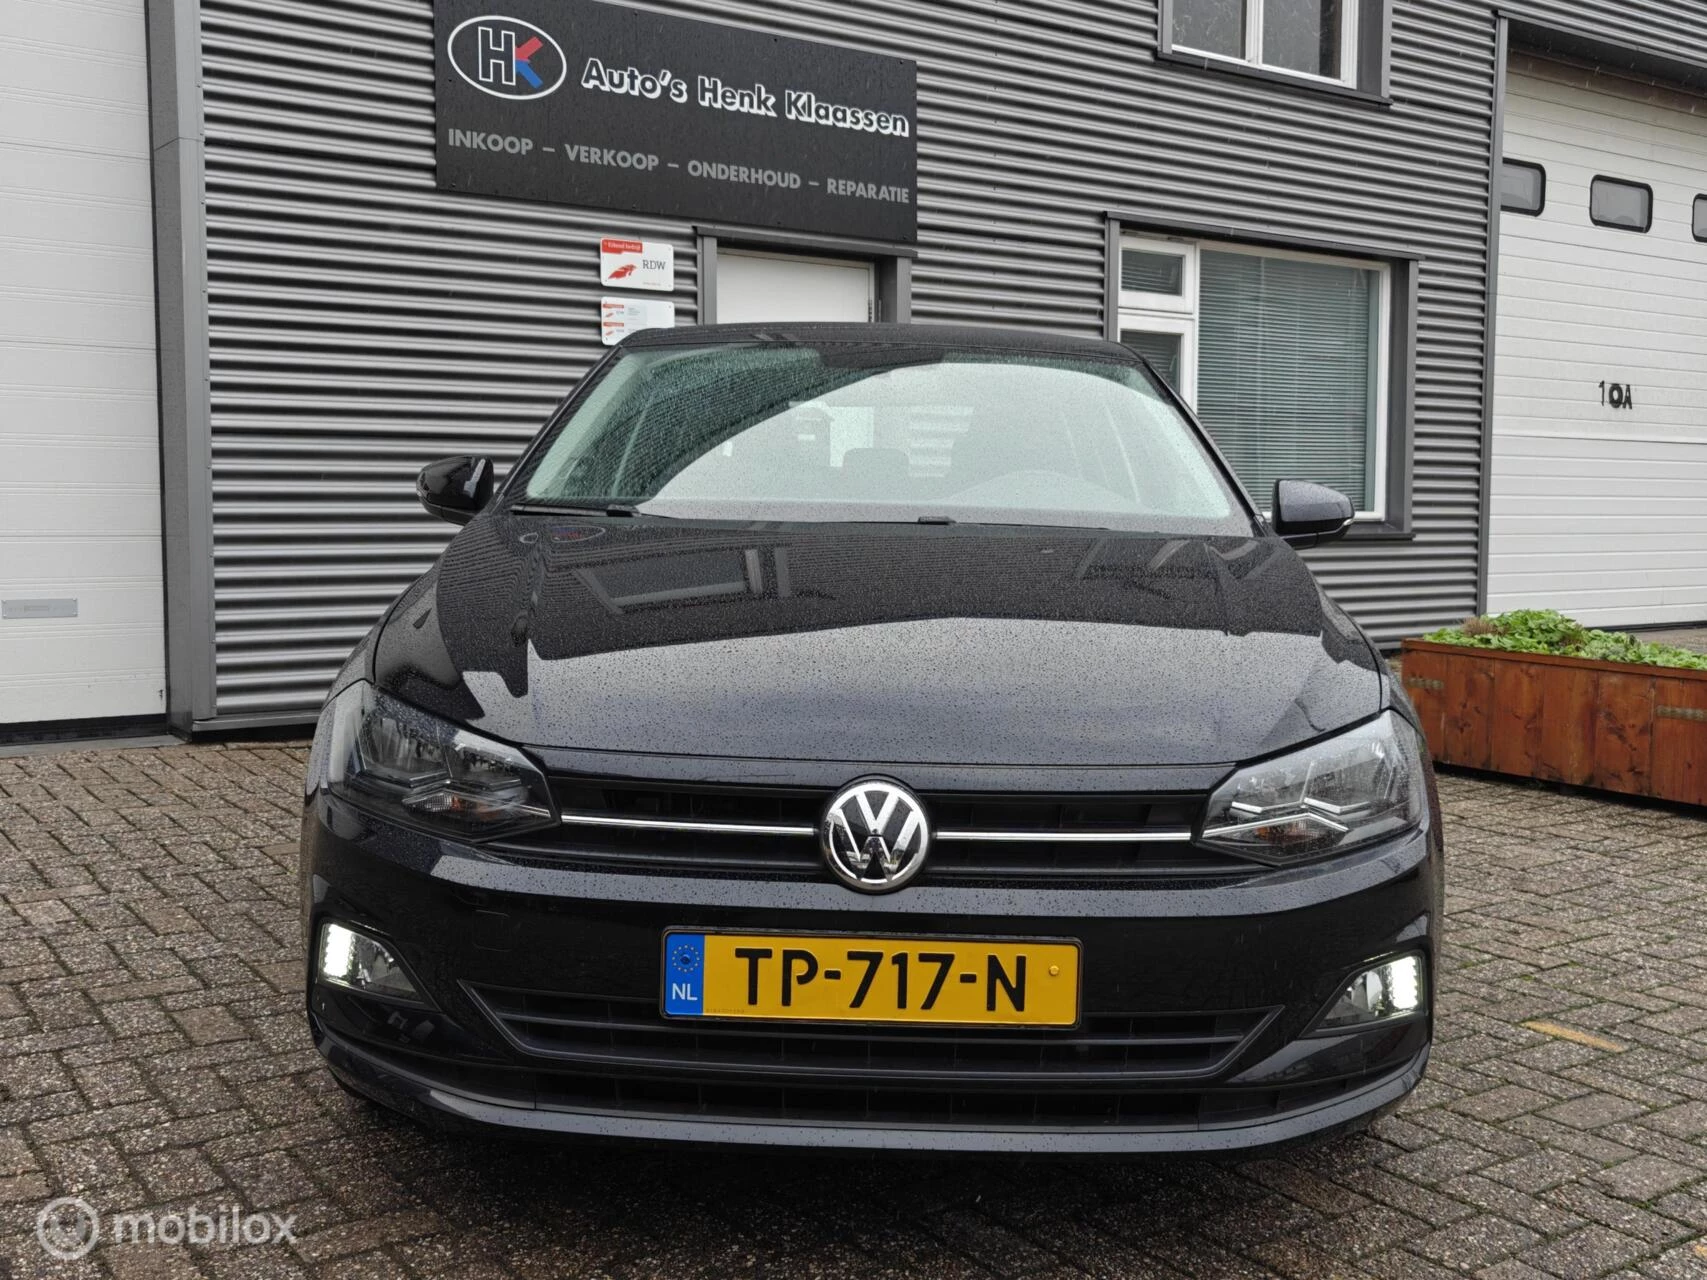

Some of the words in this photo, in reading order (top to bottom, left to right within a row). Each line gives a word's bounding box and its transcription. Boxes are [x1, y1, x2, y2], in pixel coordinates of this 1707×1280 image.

[477, 26, 544, 89] HK
[580, 57, 688, 104] Auto's
[698, 75, 778, 118] Henk
[784, 89, 910, 138] Klaassen
[448, 128, 534, 155] INKOOP
[564, 143, 660, 171] VERKOOP
[687, 159, 801, 189] ONDERHOUD
[826, 178, 910, 204] REPARATIE
[642, 259, 667, 270] RDW
[1598, 380, 1633, 410] 10A
[671, 983, 698, 1001] NL
[734, 947, 1027, 1012] TP-717-N
